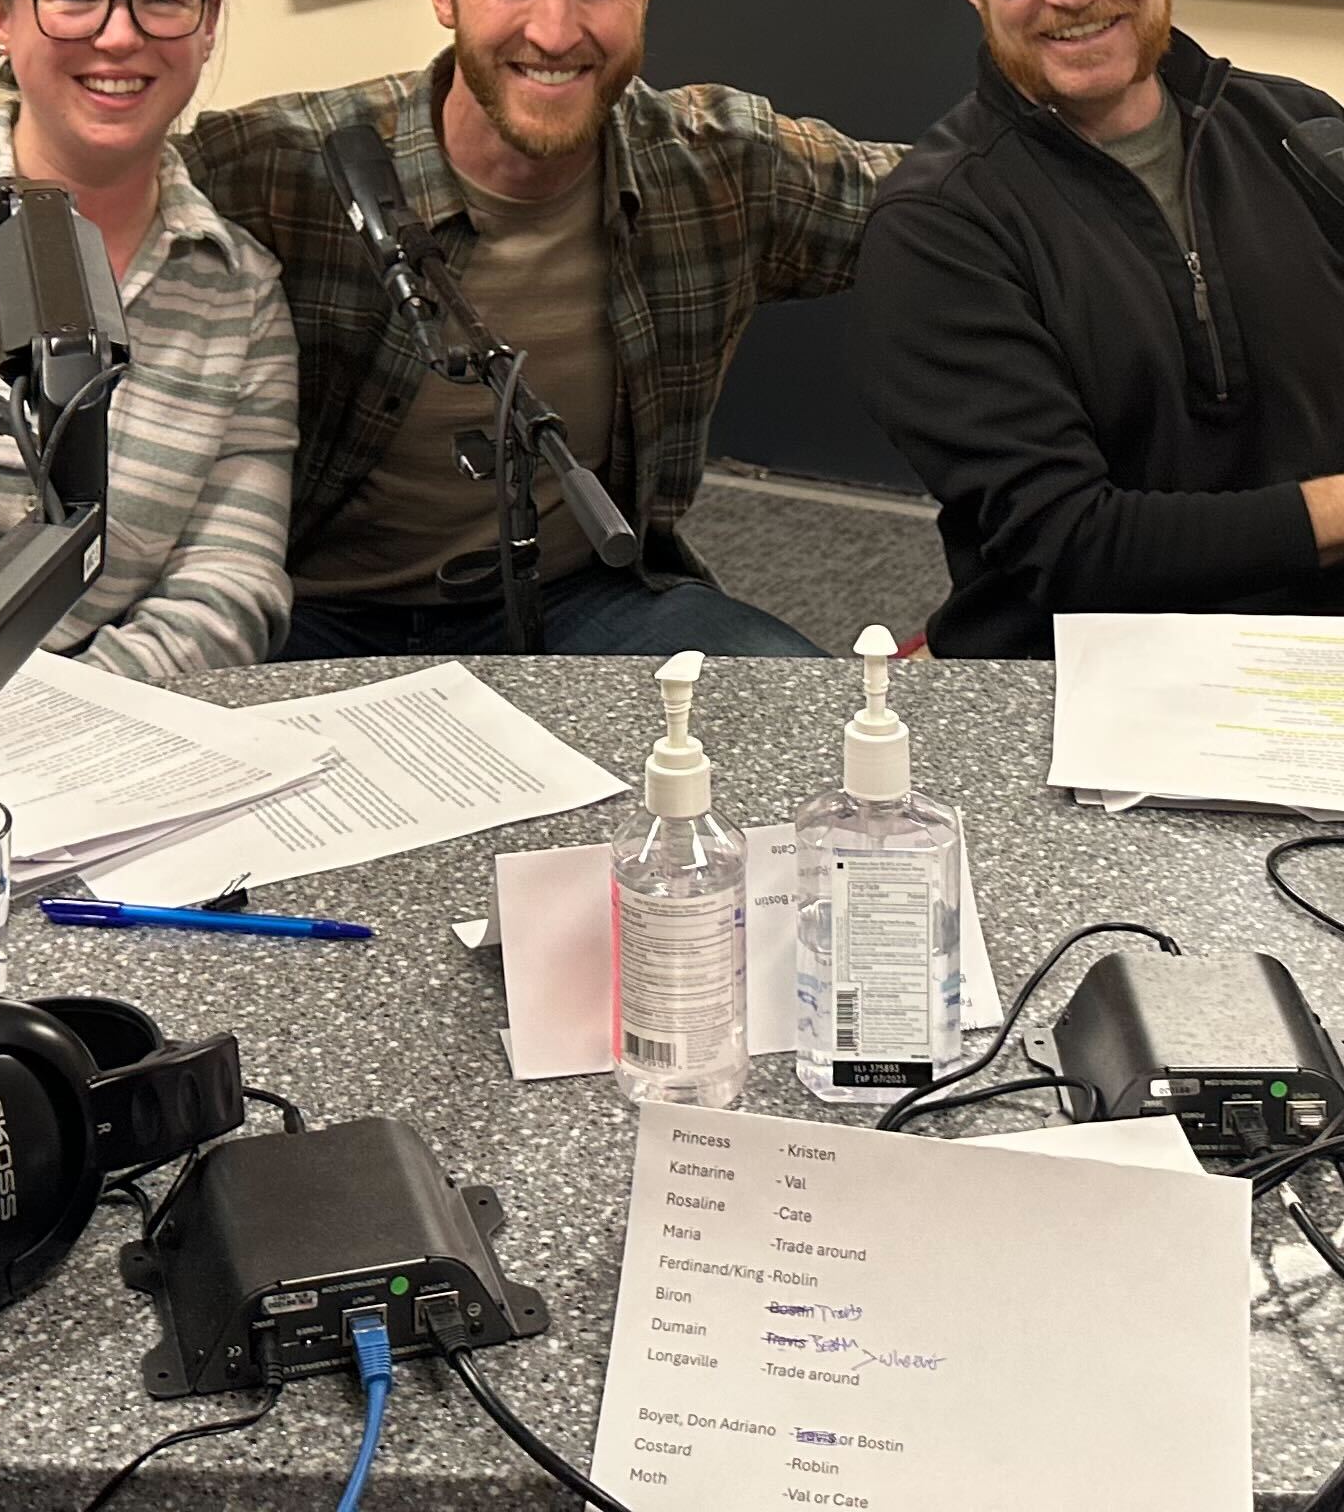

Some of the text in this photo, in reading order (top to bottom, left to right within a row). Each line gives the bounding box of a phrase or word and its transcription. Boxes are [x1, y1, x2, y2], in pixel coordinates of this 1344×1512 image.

[754, 894, 789, 906] Bostin
[96, 1122, 113, 1135] R
[672, 1129, 731, 1149] Princess
[787, 1144, 836, 1162] Kristen
[669, 1160, 735, 1181] Katharine
[785, 1175, 807, 1191] Val
[666, 1192, 726, 1212] Rosaline
[662, 1224, 701, 1241] Maria
[816, 1244, 867, 1262] around
[659, 1255, 764, 1284] Ferdinand/King
[655, 1286, 692, 1304] Biron
[651, 1317, 707, 1336] Dumain
[647, 1347, 719, 1369] Longaville
[808, 1369, 860, 1386] around
[638, 1407, 684, 1427] Boyet,
[687, 1413, 716, 1429] Don
[719, 1417, 777, 1437] Adriano
[839, 1435, 855, 1447] or
[857, 1435, 904, 1453] Bostin
[634, 1437, 693, 1457] Costard
[629, 1467, 668, 1485] Moth
[814, 1491, 830, 1505] or
[832, 1492, 869, 1510] Cate
